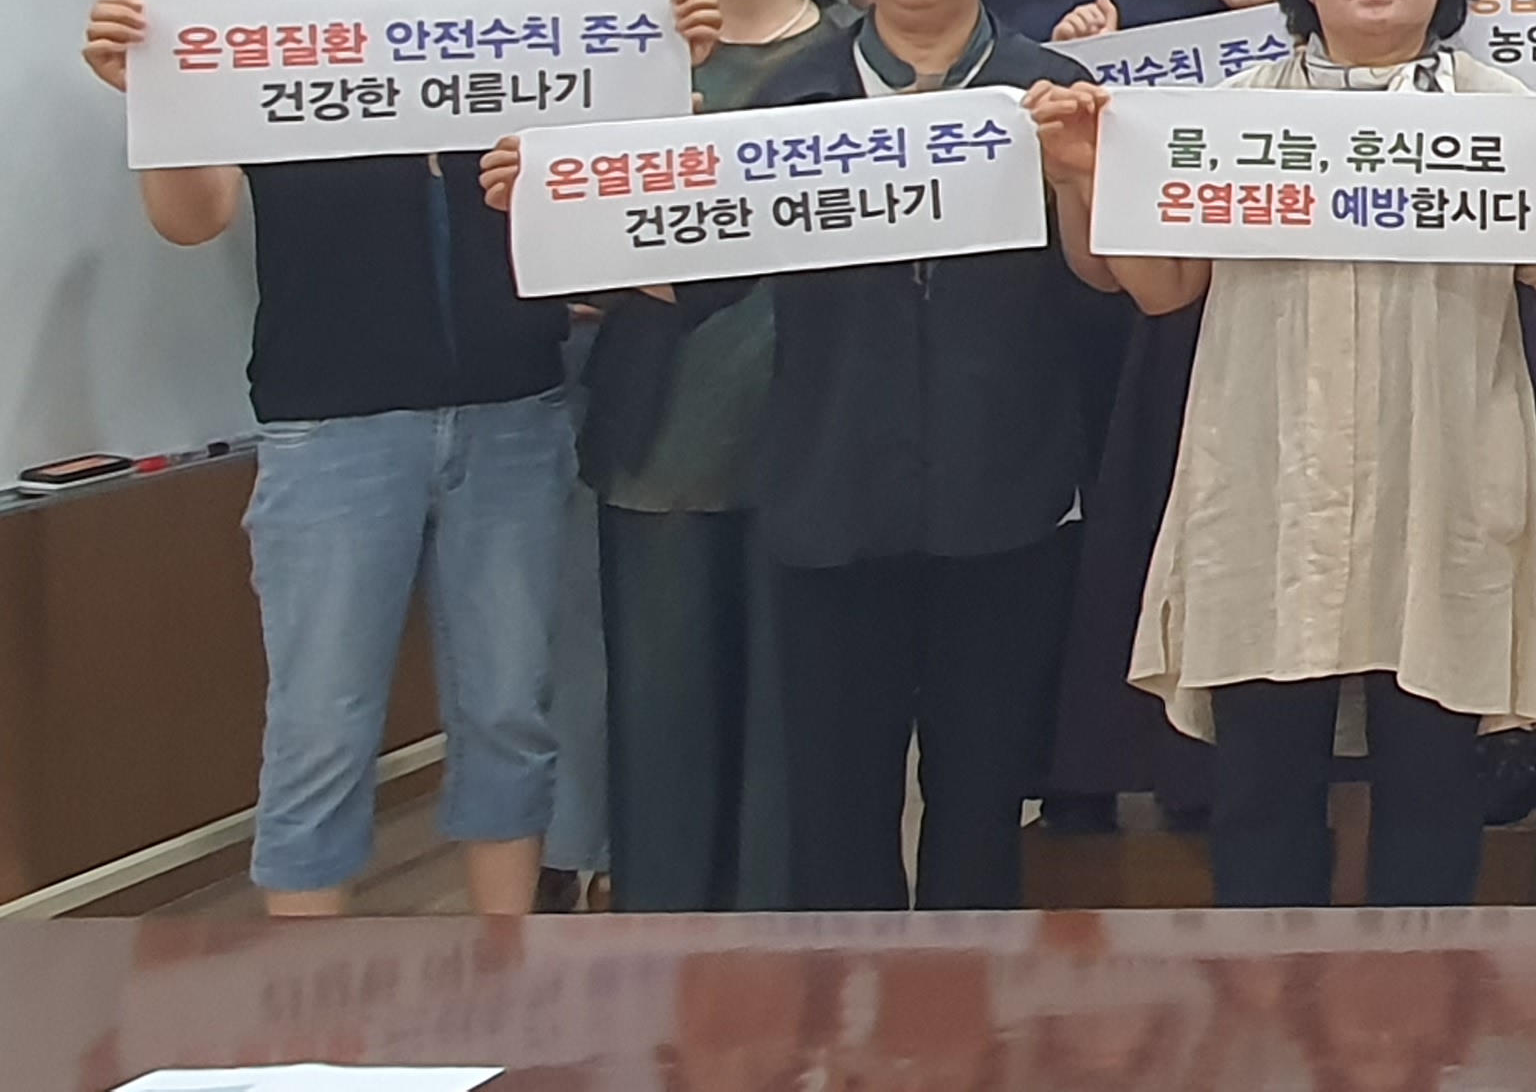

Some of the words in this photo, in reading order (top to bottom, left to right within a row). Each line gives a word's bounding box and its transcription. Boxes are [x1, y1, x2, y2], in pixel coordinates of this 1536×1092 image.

[172, 22, 368, 71] 온열질환
[385, 15, 562, 62] 안전수칙
[580, 13, 663, 56] 준수
[1096, 46, 1204, 87] 전수칙
[260, 77, 400, 123] 건강한
[420, 69, 594, 116] 여름나기
[545, 144, 718, 202] 온열질환
[736, 126, 908, 180] 안전수칙
[926, 119, 1011, 166] 준수
[1167, 128, 1219, 171] 물,
[1236, 129, 1329, 175] 그늘,
[1345, 130, 1505, 174] 휴식으로
[624, 195, 753, 248] 건강한
[772, 180, 943, 231] 여름나기
[1157, 180, 1315, 226] 온열질환
[1331, 187, 1531, 231] 예방합시다
